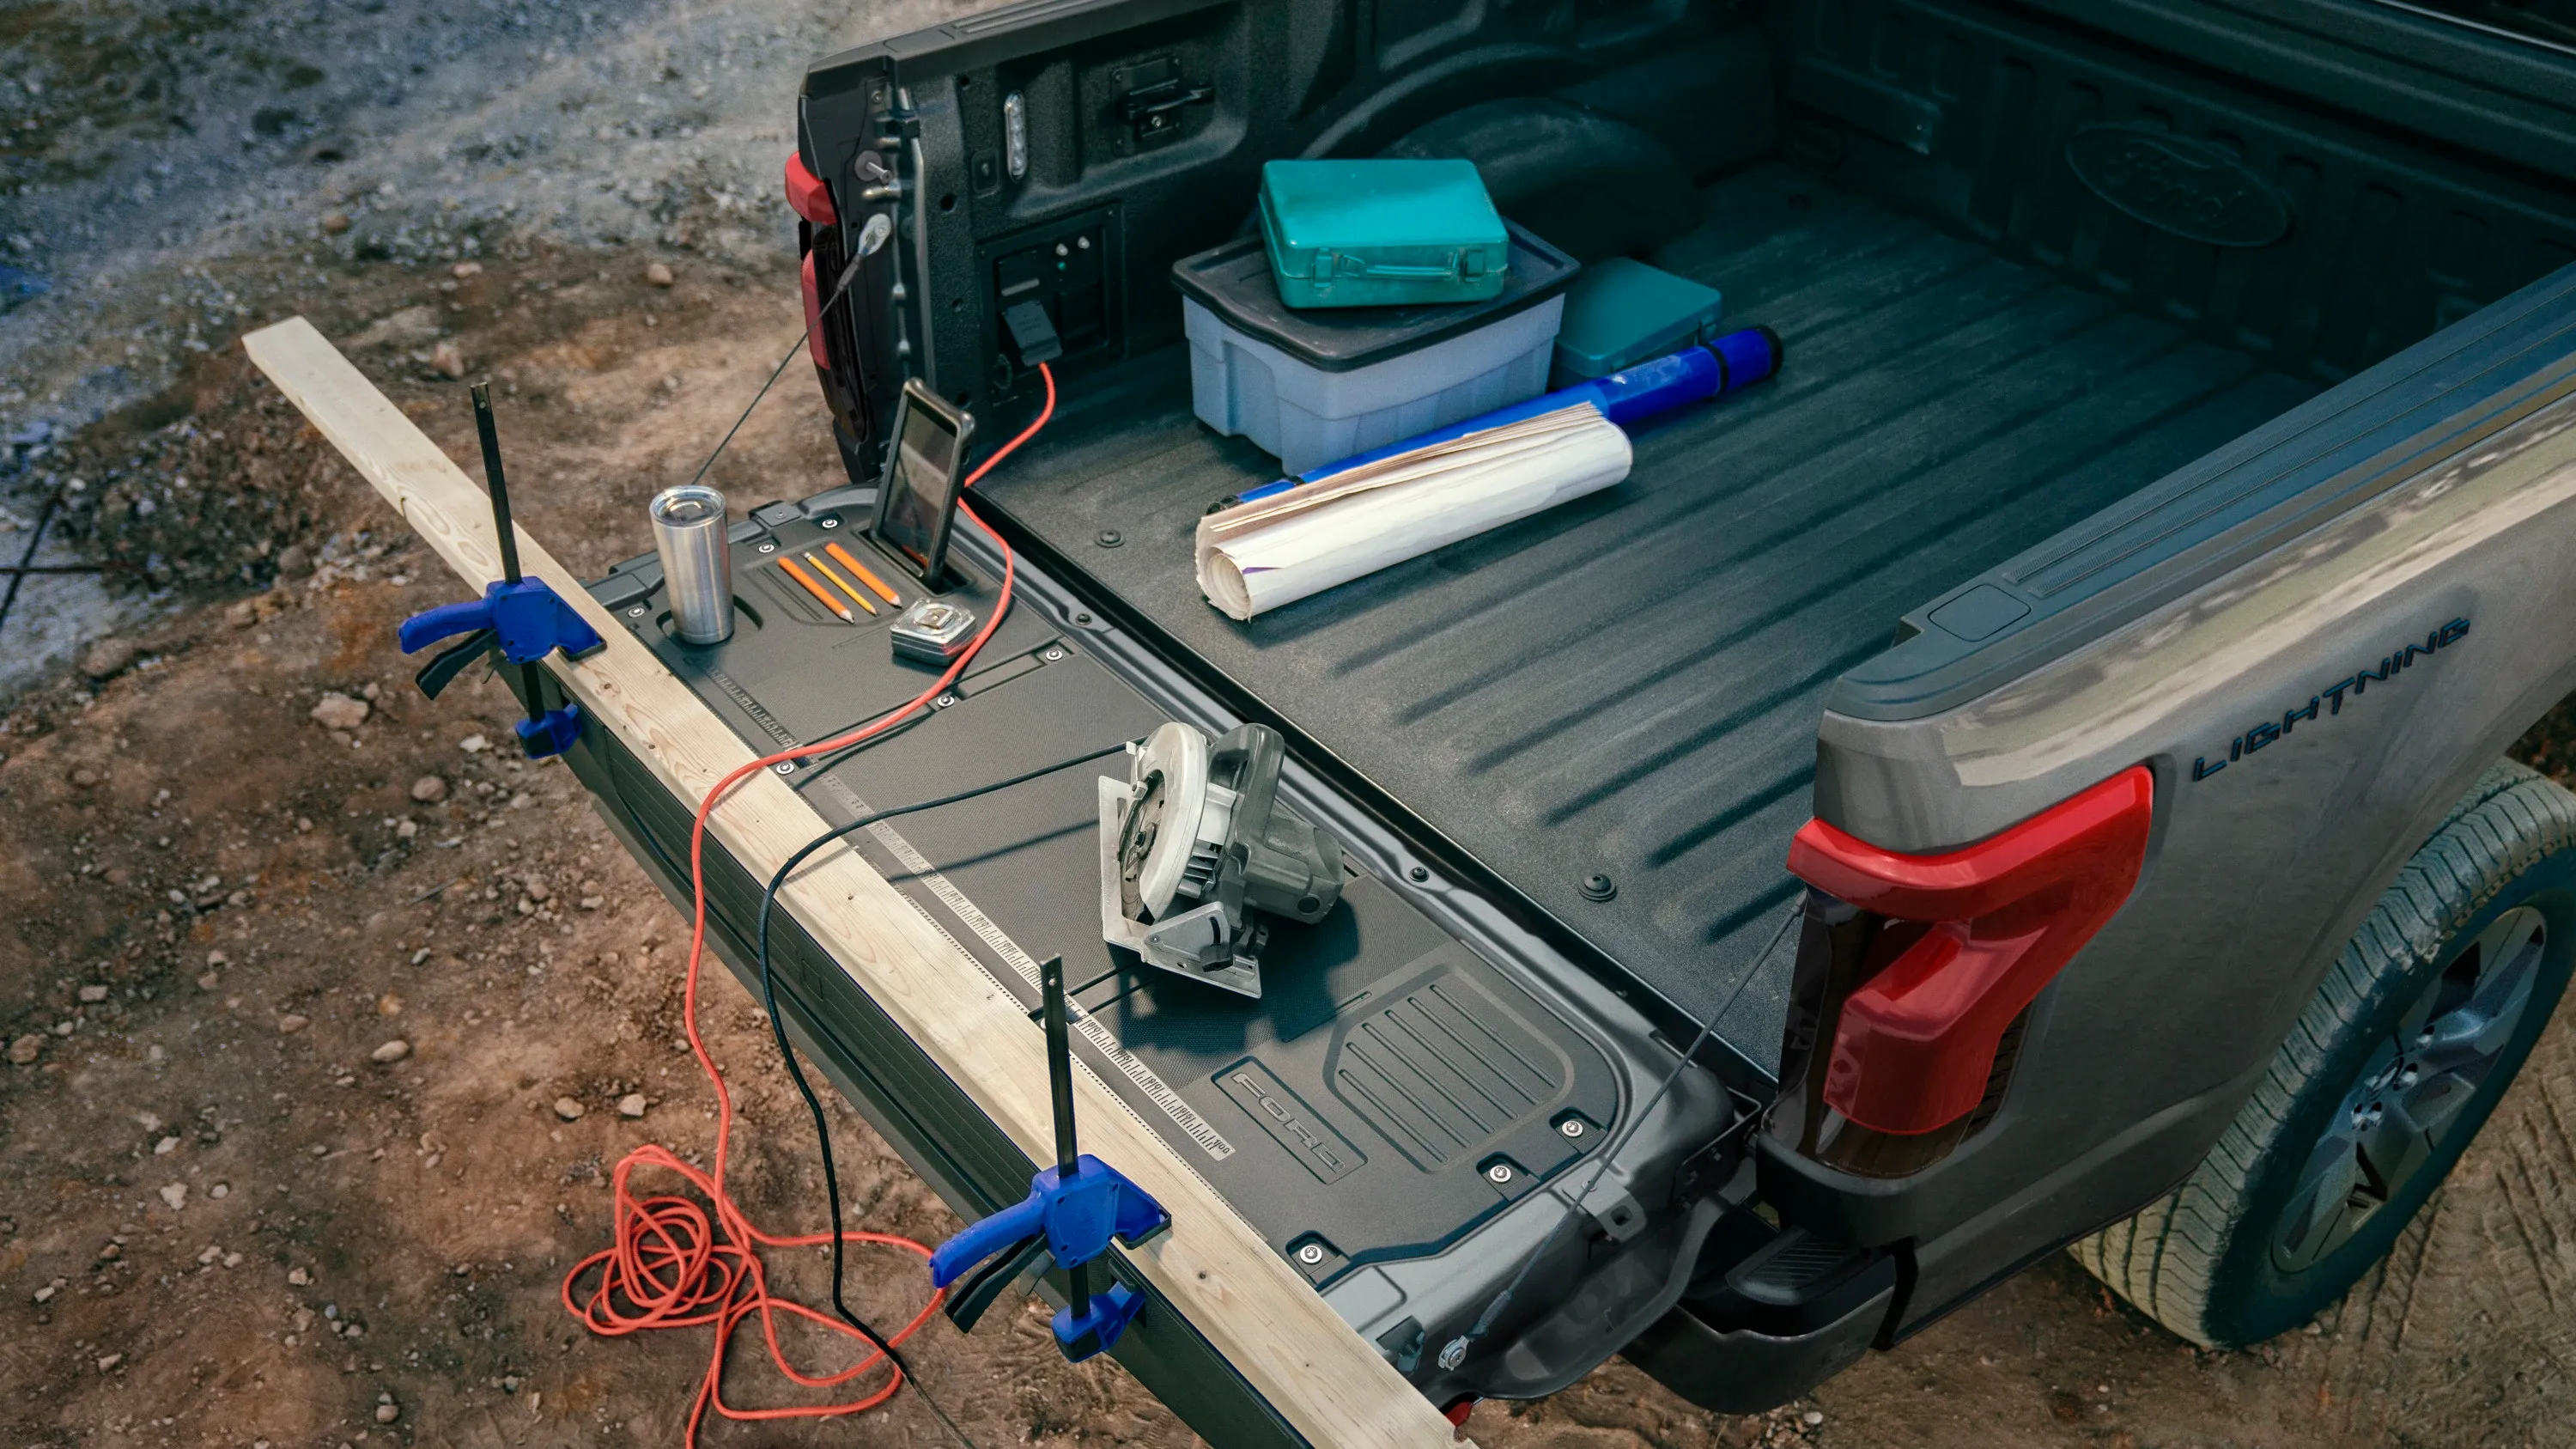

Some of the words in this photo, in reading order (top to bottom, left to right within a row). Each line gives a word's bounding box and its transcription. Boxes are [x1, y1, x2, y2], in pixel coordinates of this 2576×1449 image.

[2192, 617, 2470, 782] LIGHTNING
[1213, 1139, 1230, 1154] 100
[1230, 1072, 1346, 1174] FORD
